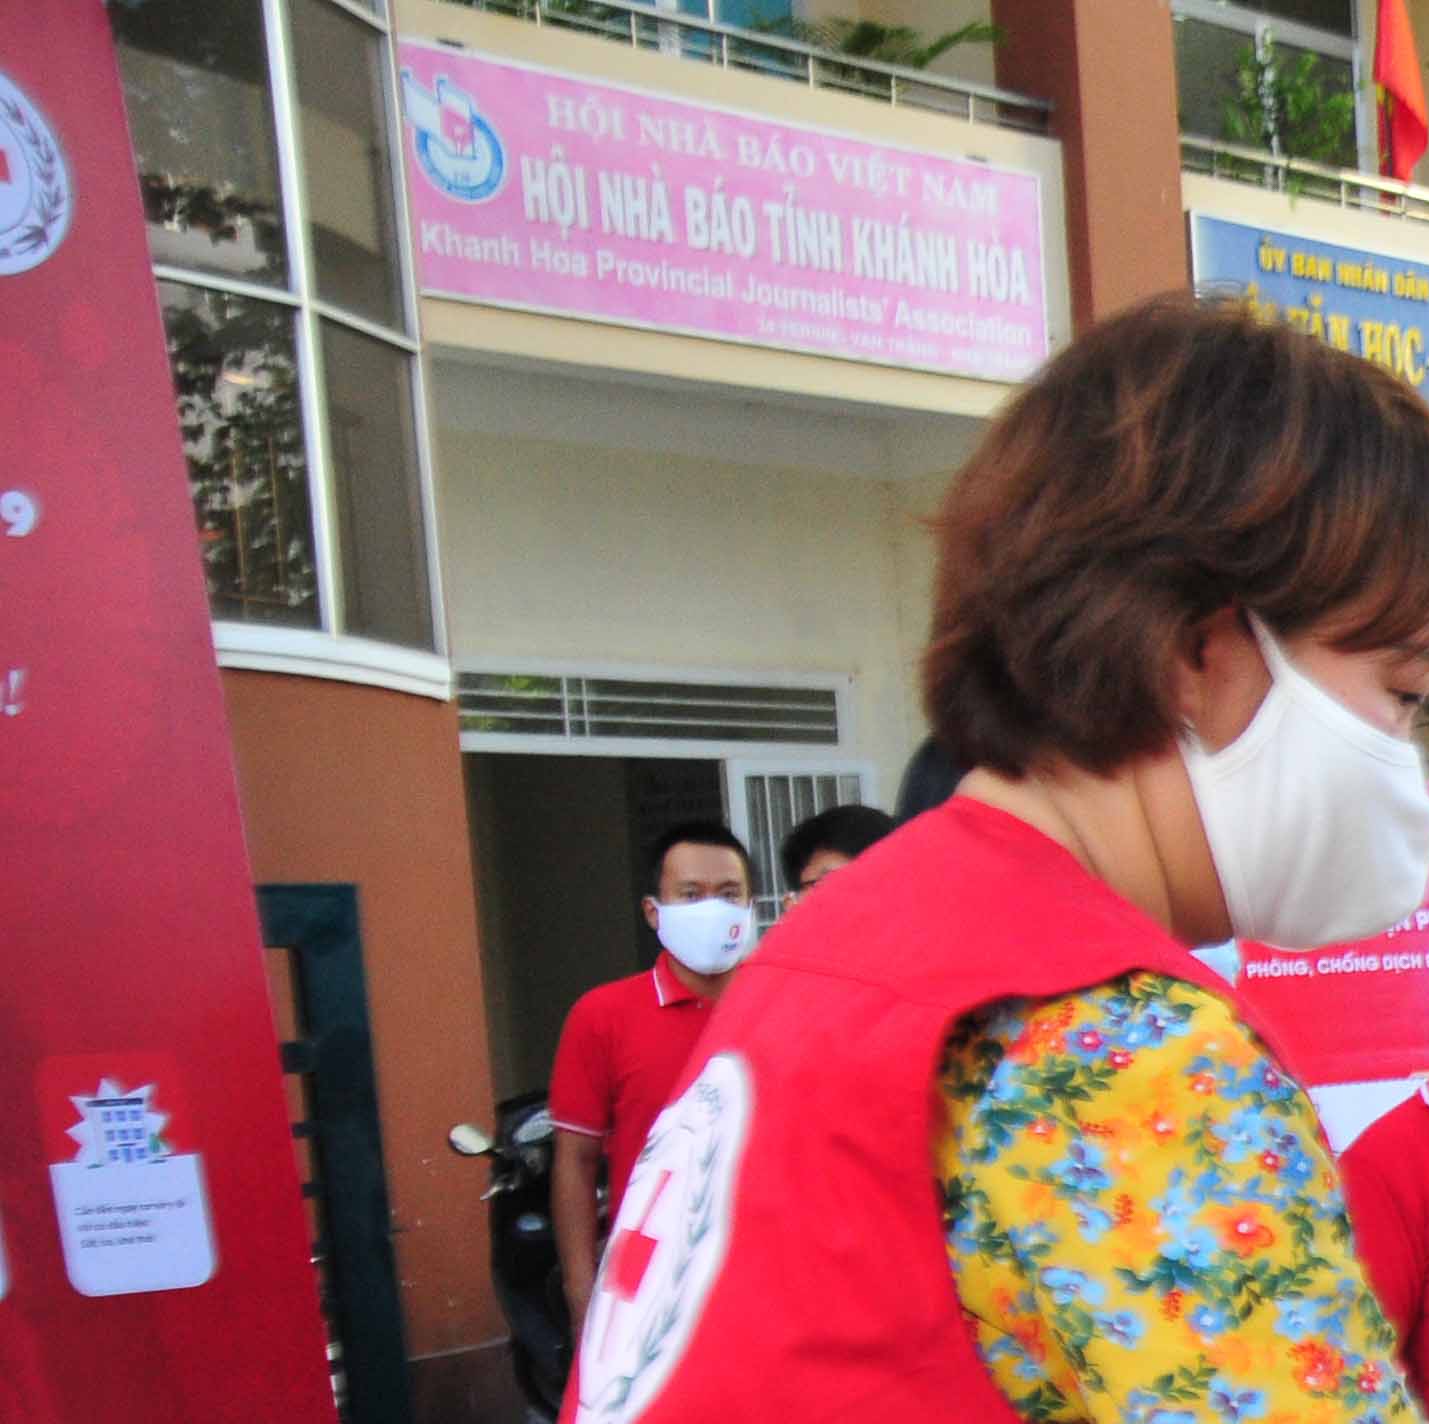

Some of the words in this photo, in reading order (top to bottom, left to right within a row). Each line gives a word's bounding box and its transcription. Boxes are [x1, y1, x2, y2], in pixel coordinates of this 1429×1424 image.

[547, 91, 626, 142] HỘI
[638, 113, 728, 161] NHÀ
[736, 132, 817, 178] BÁO
[826, 151, 914, 199] VIỆT
[921, 171, 1000, 214] NAM
[420, 219, 521, 268] Khanh
[529, 238, 589, 278] Hoa
[595, 249, 735, 298] Provincial
[894, 299, 1033, 345] Association
[520, 144, 592, 241] HỘI
[599, 160, 674, 243] NHÀ
[684, 174, 756, 257] BÁO
[763, 182, 844, 273] TỈNH
[852, 212, 960, 294] KHÁNH
[968, 229, 1031, 305] HÒA
[1291, 251, 1332, 282] BAN
[1317, 952, 1379, 975] CHỐNG
[1382, 953, 1423, 973] DỊCH
